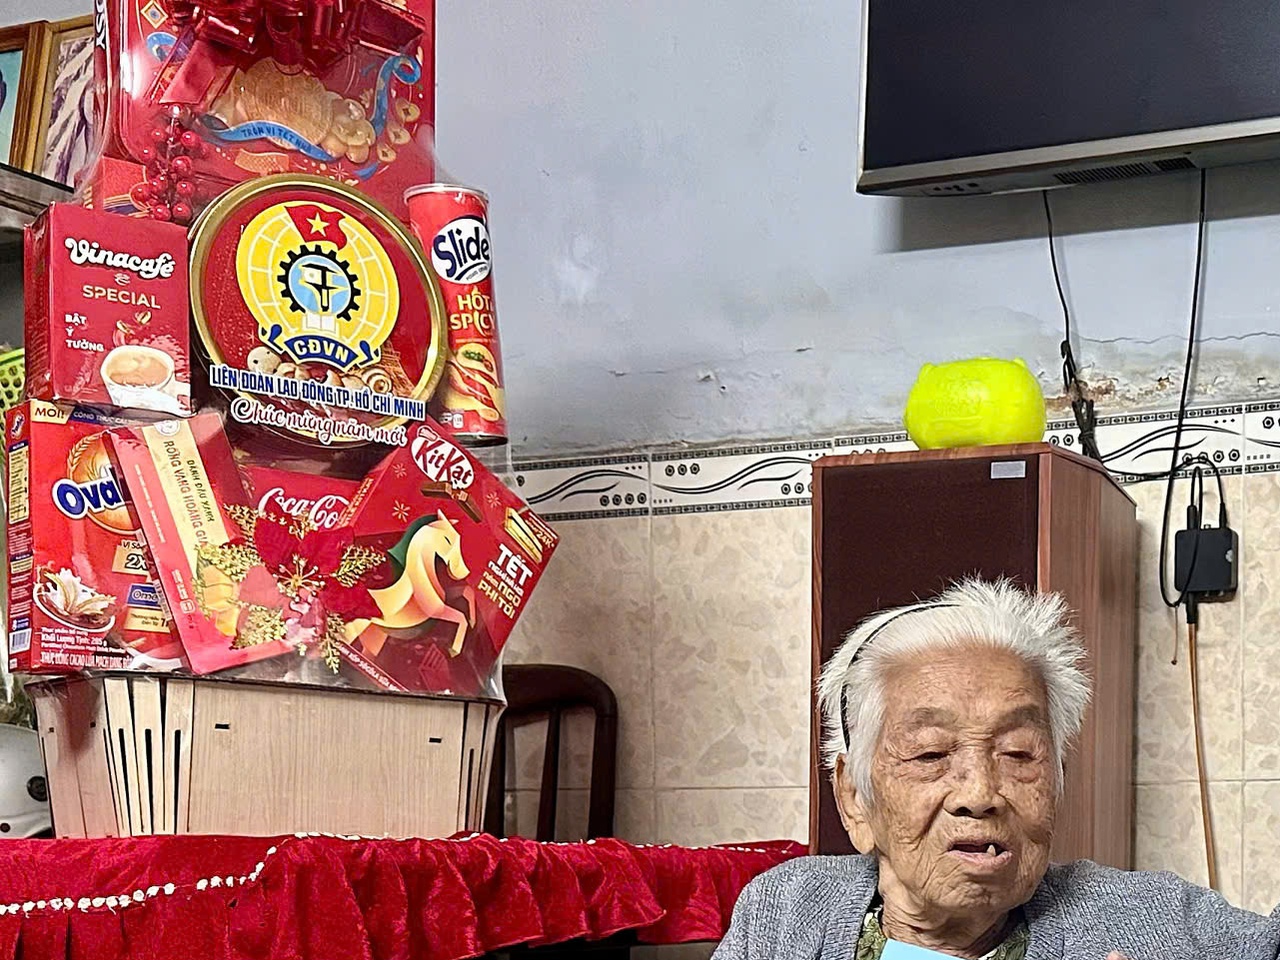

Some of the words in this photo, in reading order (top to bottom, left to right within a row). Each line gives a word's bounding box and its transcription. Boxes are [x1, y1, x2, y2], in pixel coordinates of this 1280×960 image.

[64, 237, 176, 279] Vinacafé
[433, 226, 490, 278] Slide
[82, 285, 161, 309] SPECIAL
[458, 288, 489, 312] HOT
[65, 312, 87, 326] BẬT
[449, 311, 496, 335] SPICY
[65, 338, 105, 352] TƯỞNG
[293, 338, 350, 364] CĐVN
[211, 366, 237, 387] LIÊN
[240, 370, 274, 393] ĐOÀN
[277, 378, 298, 398] LAO
[300, 380, 333, 404] ĐỘNG
[372, 392, 391, 414] CHÍ
[394, 399, 425, 421] MINH
[232, 398, 285, 424] Chúc
[288, 411, 334, 444] mừng
[334, 419, 372, 440] năm
[374, 426, 407, 446] mới
[414, 438, 474, 486] KitKat
[258, 487, 351, 528] Coca-Co
[499, 543, 533, 586] TẾT
[478, 579, 499, 602] PHI
[498, 596, 516, 619] TỚI
